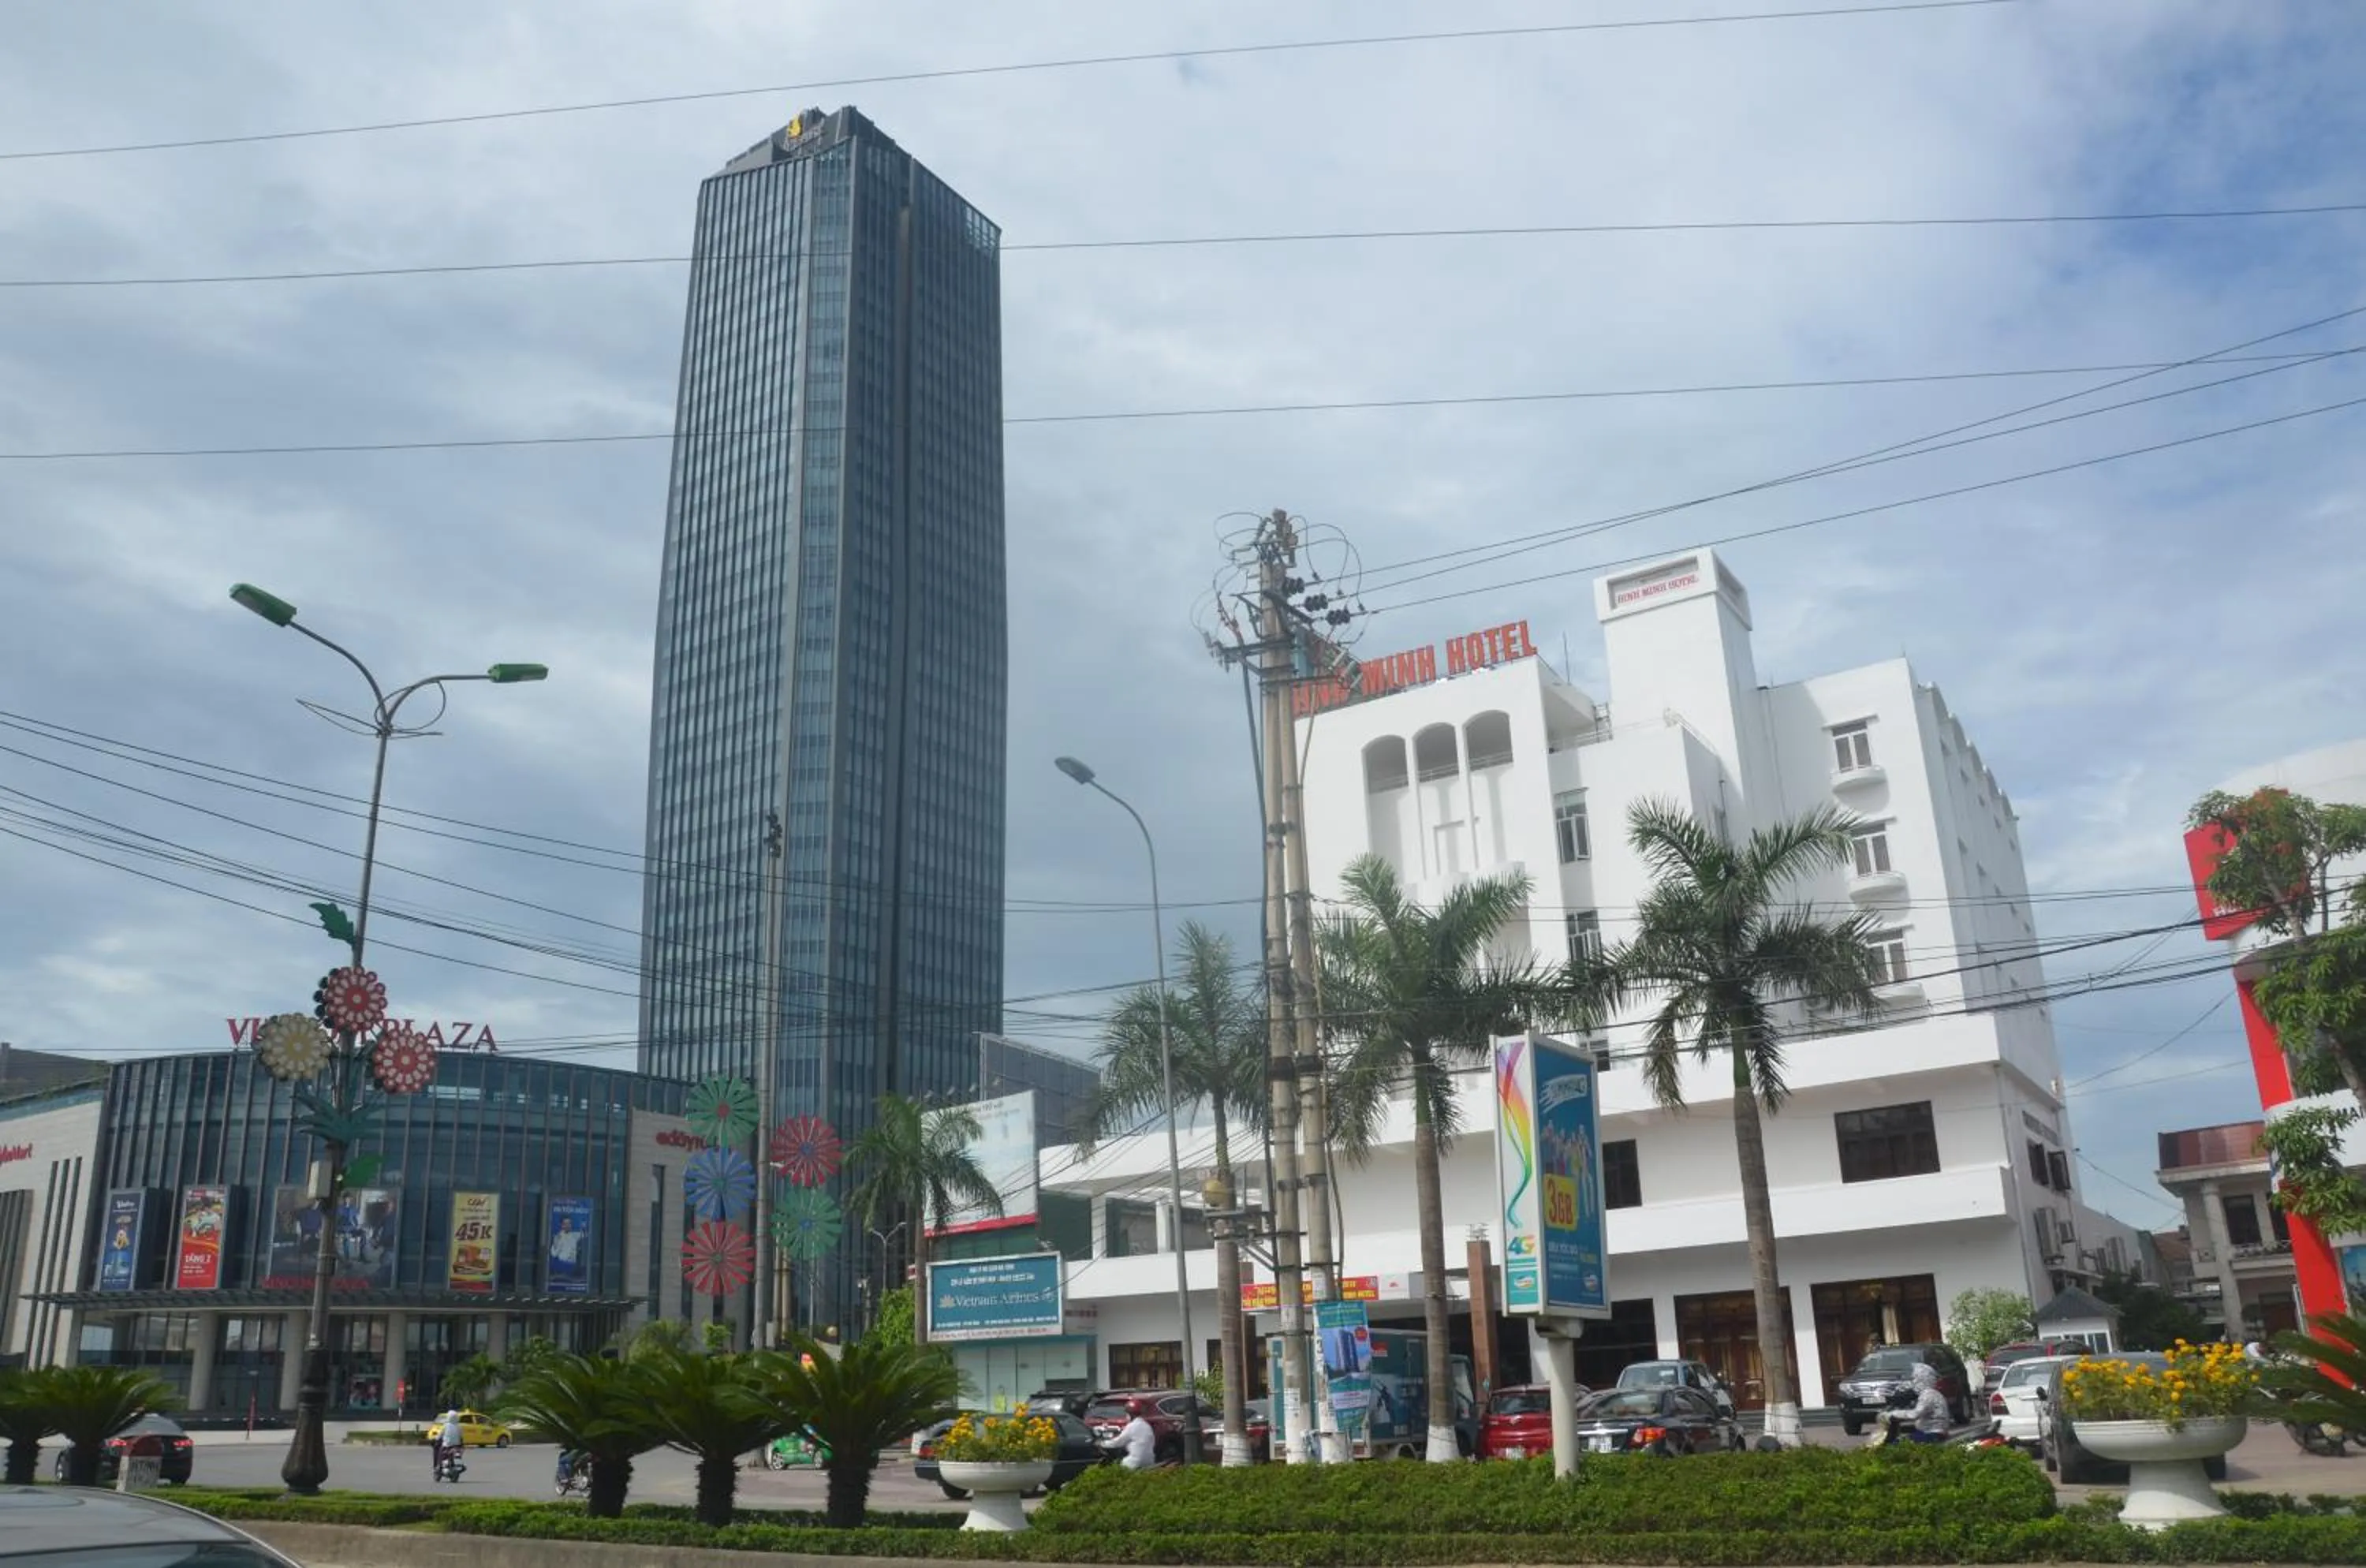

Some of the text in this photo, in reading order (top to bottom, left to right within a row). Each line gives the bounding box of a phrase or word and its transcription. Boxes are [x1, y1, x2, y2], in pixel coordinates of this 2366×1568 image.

[1359, 644, 1436, 696] MINH
[1446, 619, 1537, 675] HOTEL
[1547, 1178, 1573, 1225] 3GB
[454, 1222, 493, 1241] 45K
[1507, 1234, 1536, 1255] 4G
[955, 1290, 1039, 1308] Vietnam Airlines
